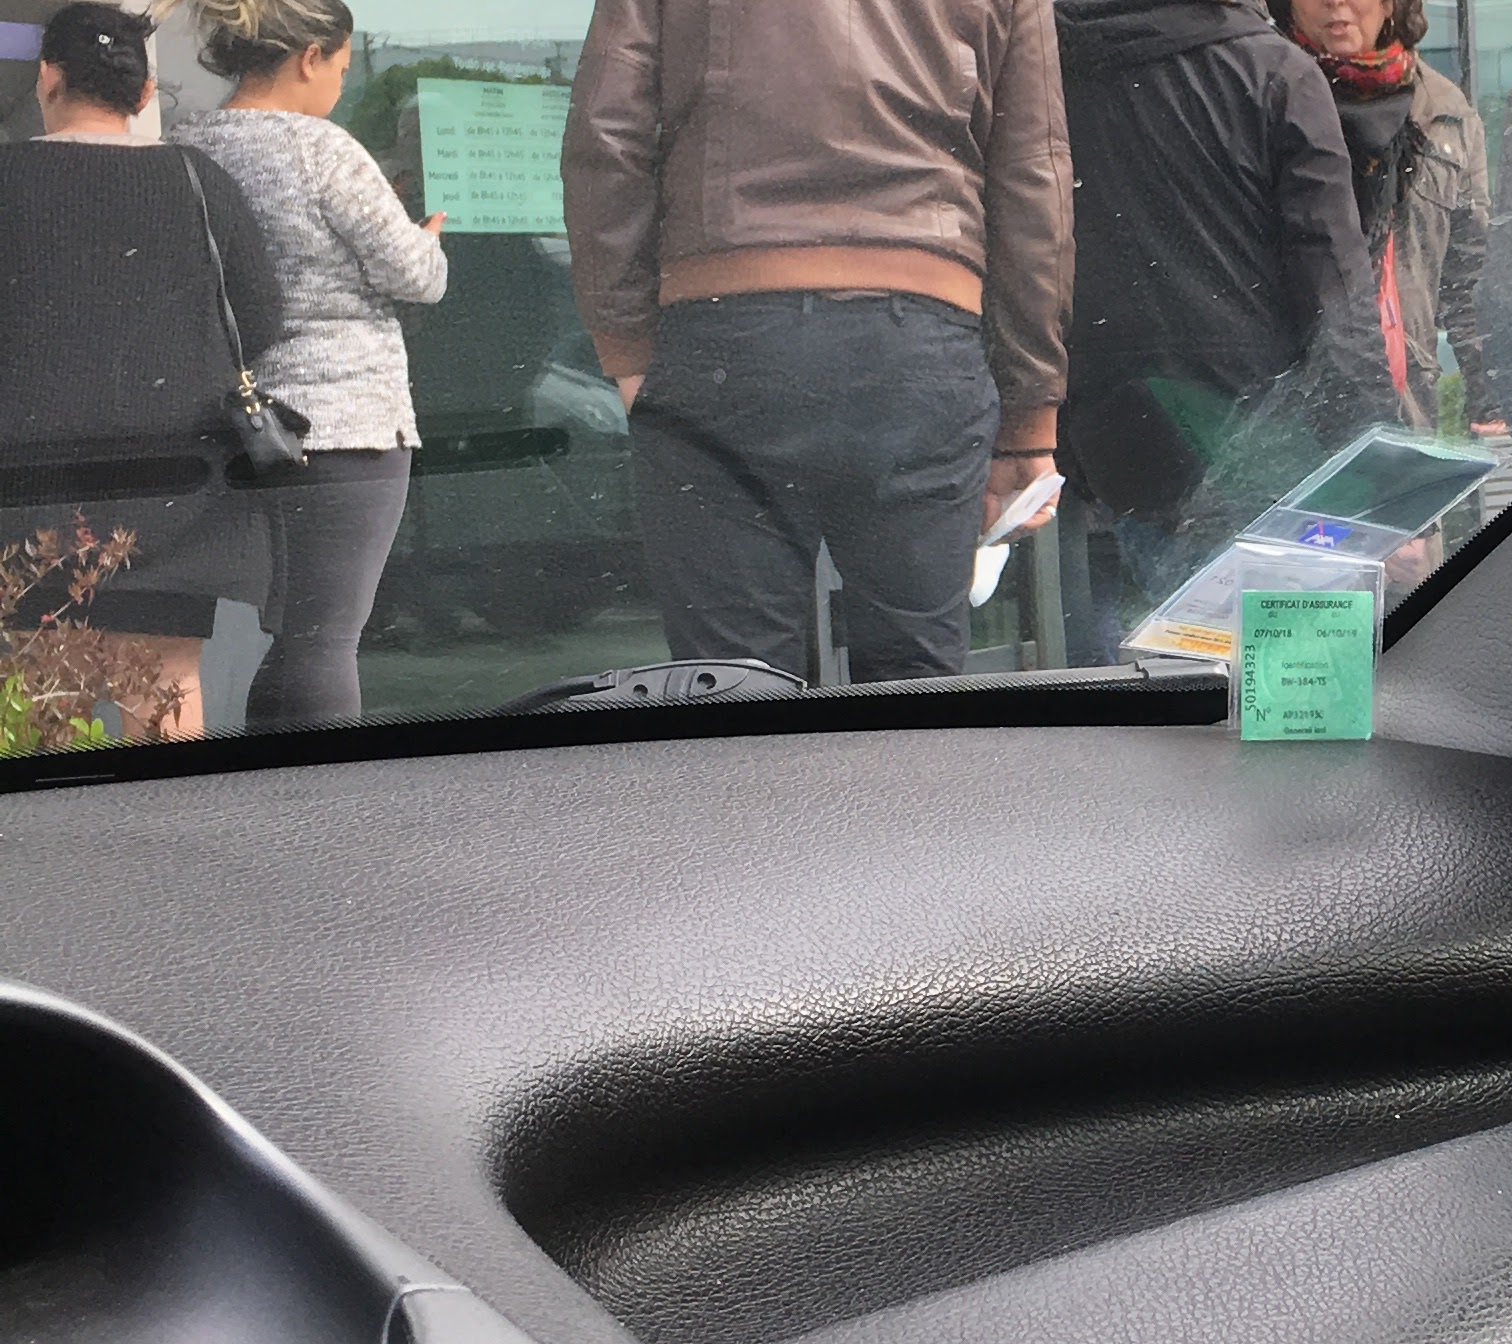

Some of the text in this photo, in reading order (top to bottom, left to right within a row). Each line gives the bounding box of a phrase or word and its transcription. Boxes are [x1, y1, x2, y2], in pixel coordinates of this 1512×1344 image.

[1260, 600, 1354, 609] CERTIFICAT D'ASSURANCE
[1244, 644, 1257, 712] 50194323
